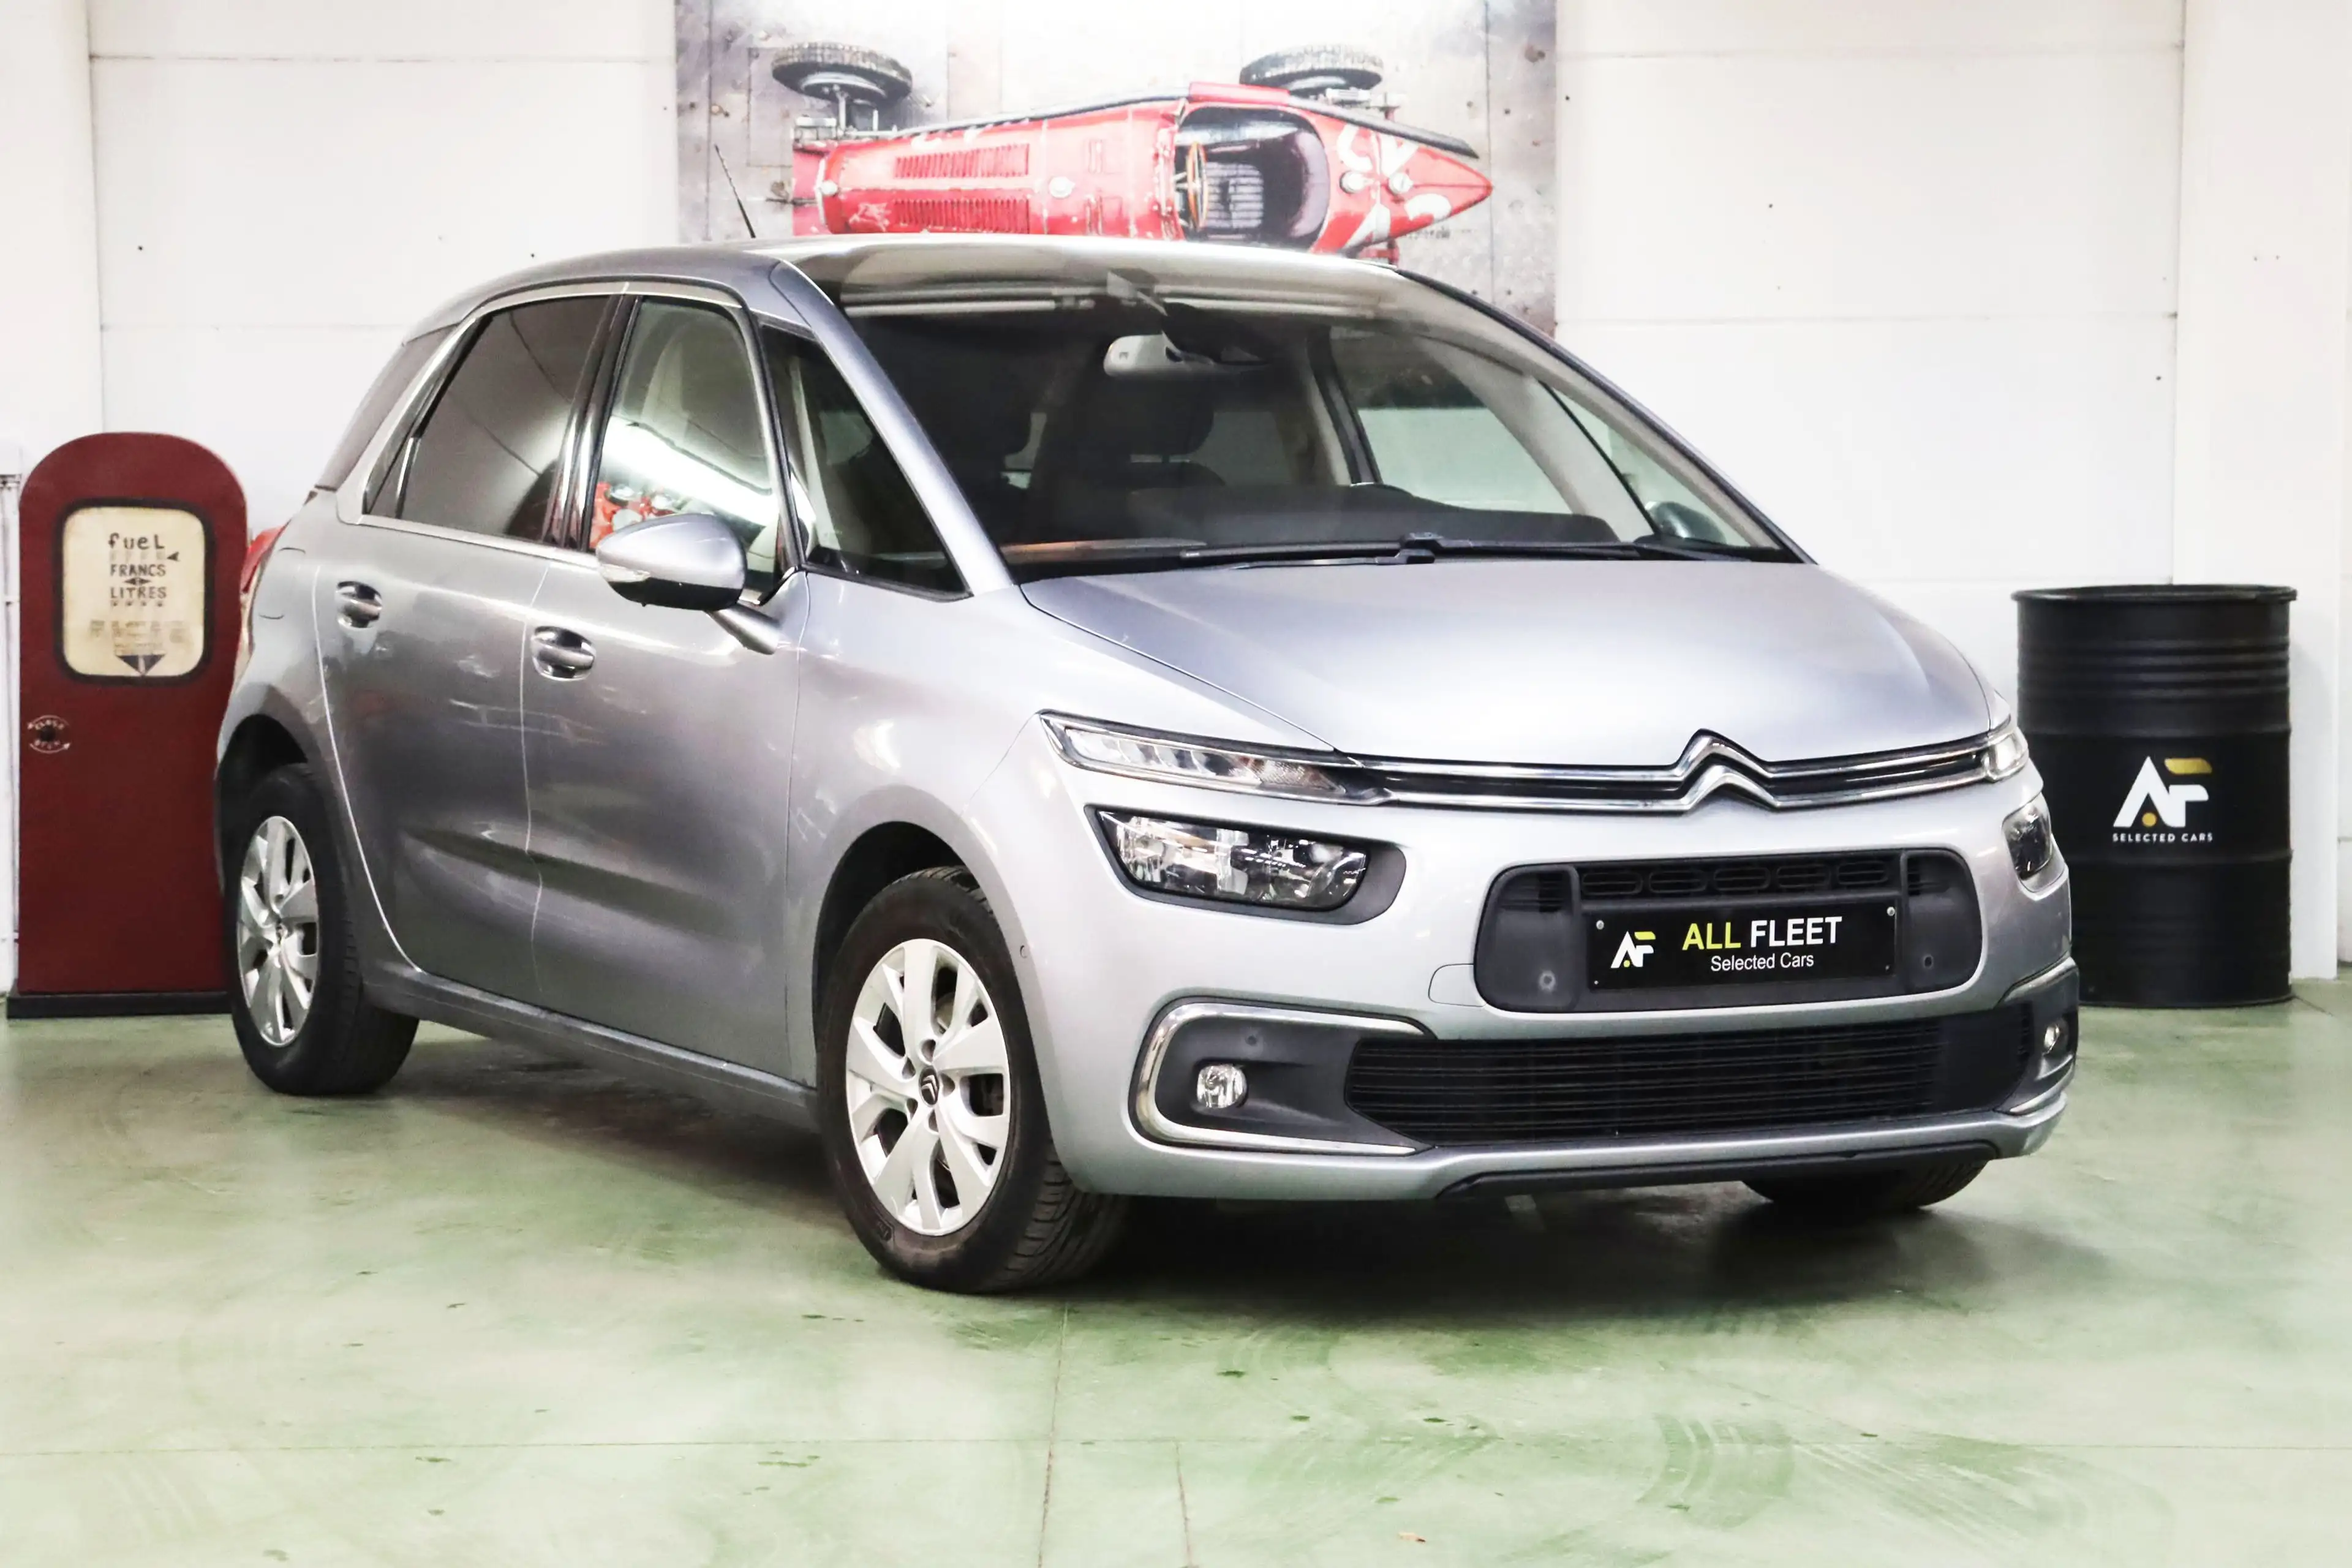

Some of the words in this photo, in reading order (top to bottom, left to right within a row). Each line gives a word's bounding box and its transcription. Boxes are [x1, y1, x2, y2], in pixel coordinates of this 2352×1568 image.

[110, 564, 166, 577] FRANCS
[110, 586, 167, 599] LITRES
[2113, 755, 2212, 827] AF
[2113, 833, 2175, 843] SELECTED
[2181, 833, 2213, 843] CARS
[1682, 922, 1741, 951] ALL
[1751, 916, 1842, 948] FLEET
[1711, 956, 1775, 972] Selected
[1780, 952, 1814, 968] Cars
